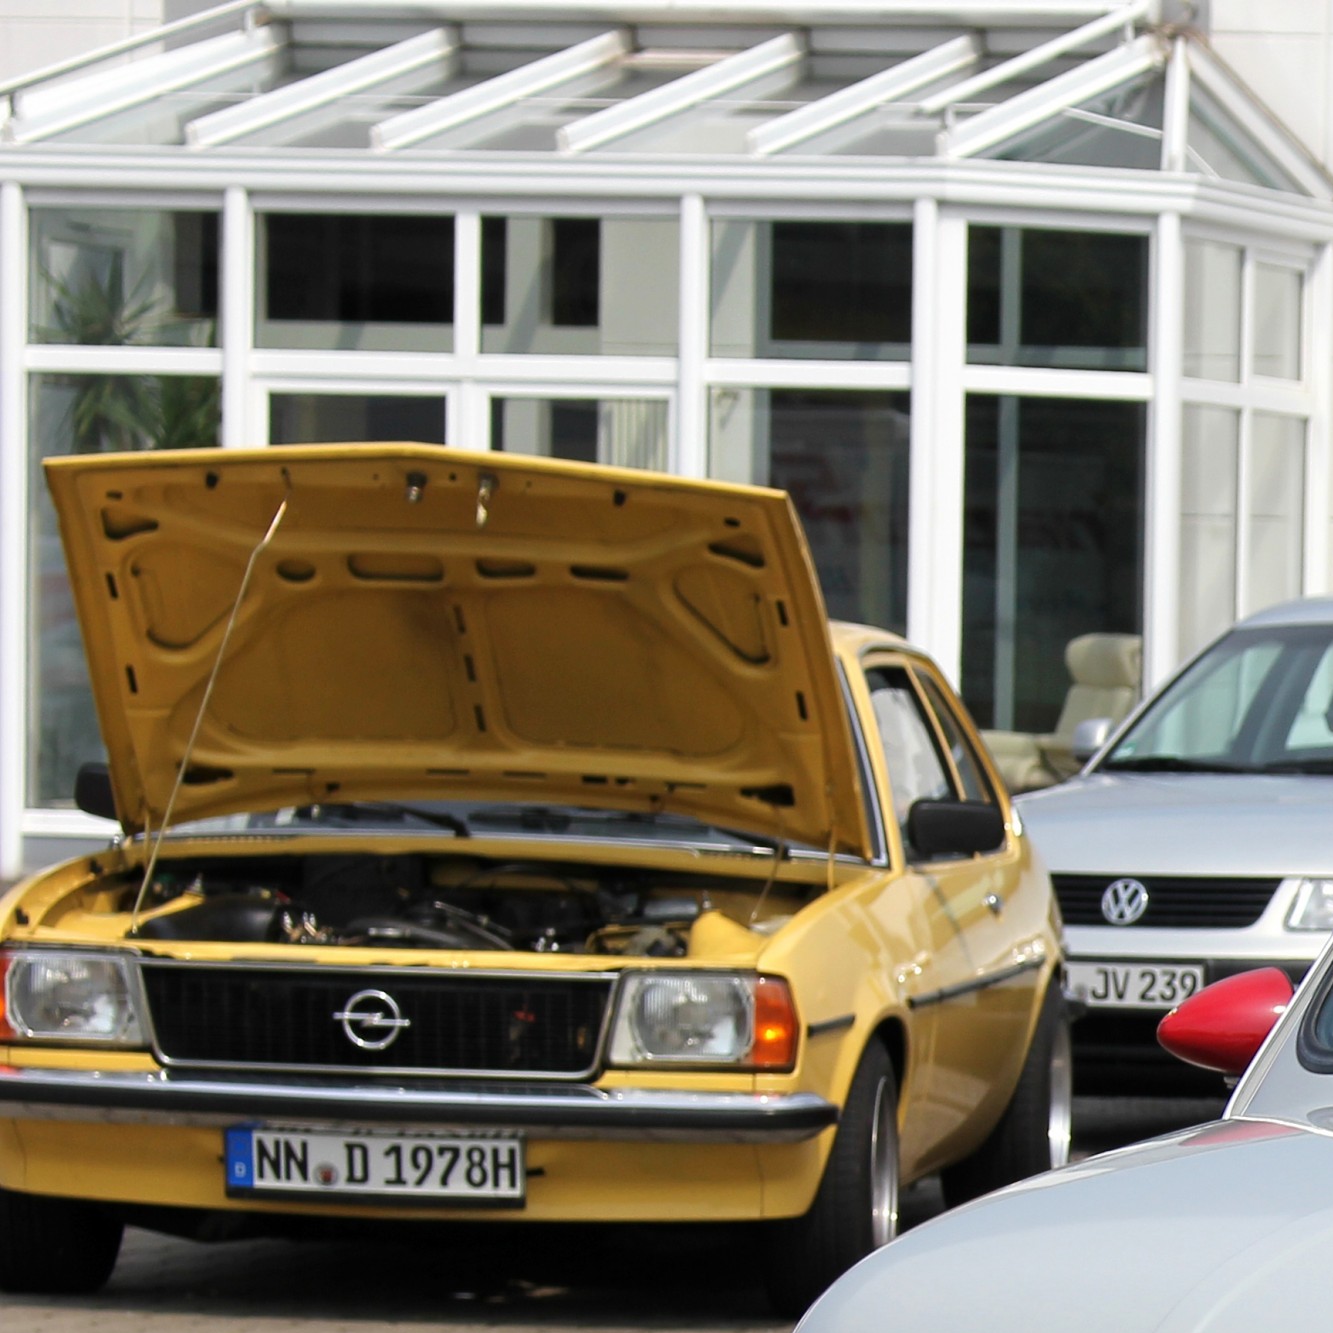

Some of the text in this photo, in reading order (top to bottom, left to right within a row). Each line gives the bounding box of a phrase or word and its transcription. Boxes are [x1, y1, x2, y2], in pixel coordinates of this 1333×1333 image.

[1091, 968, 1197, 1002] JV 239
[256, 1138, 517, 1189] NN D 1978H
